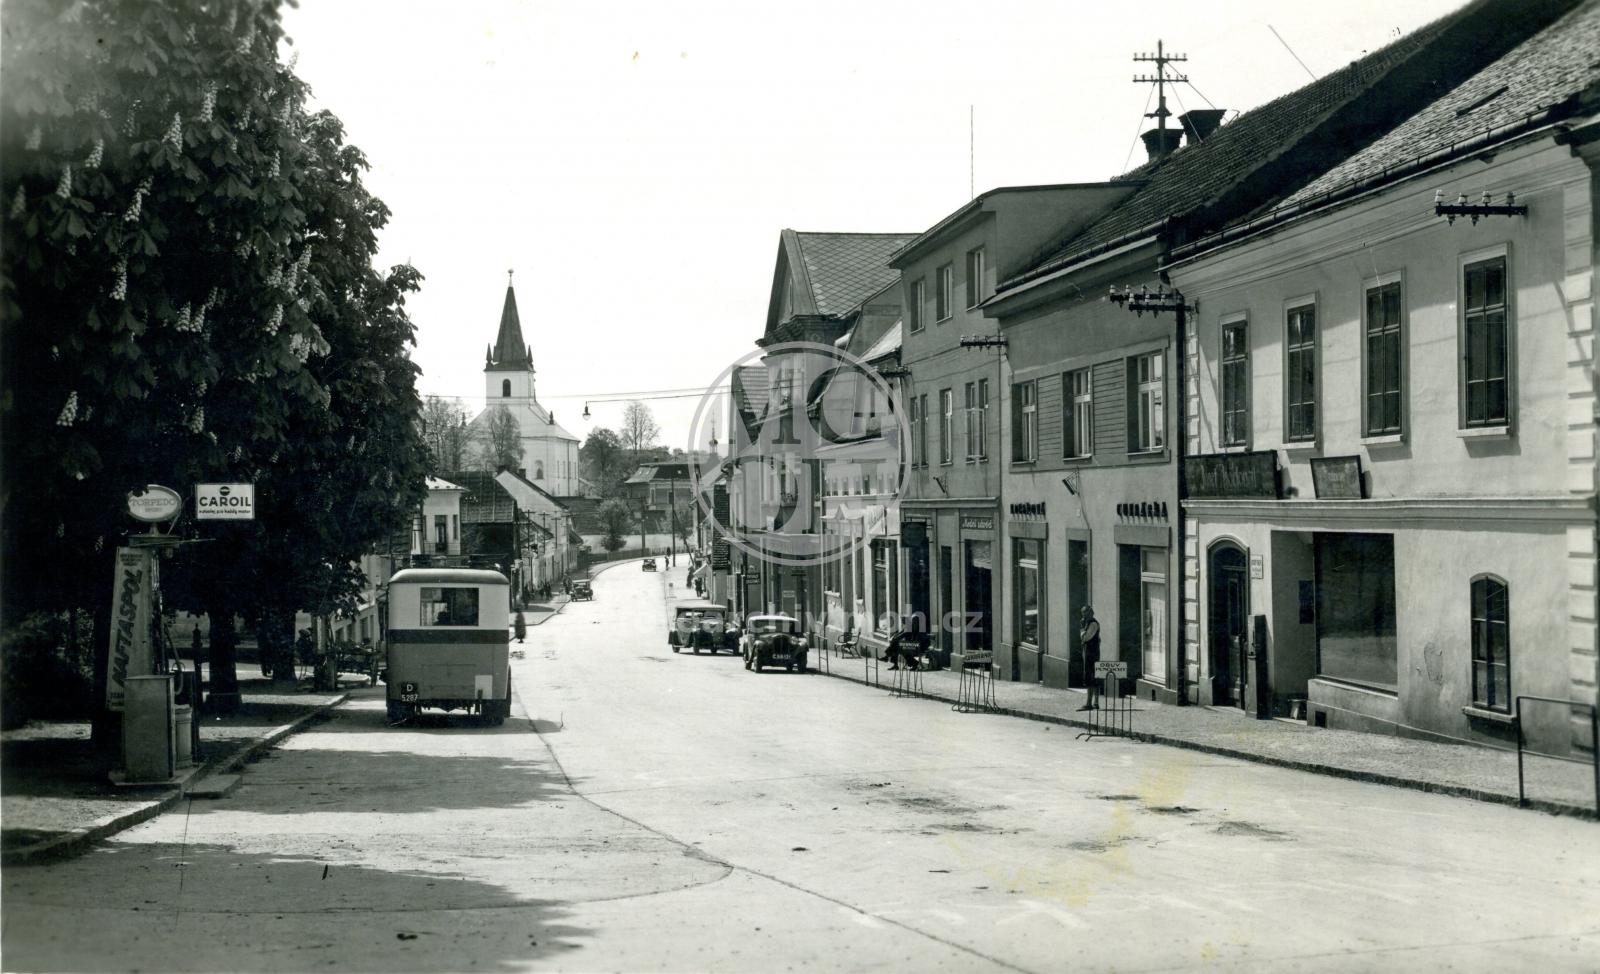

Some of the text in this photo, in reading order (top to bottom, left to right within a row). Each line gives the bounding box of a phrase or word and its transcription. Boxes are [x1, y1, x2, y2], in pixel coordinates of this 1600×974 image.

[131, 498, 176, 507] TORPEDO
[199, 497, 252, 507] CAROIL
[112, 569, 142, 688] NAFTASPOL
[406, 683, 413, 692] D
